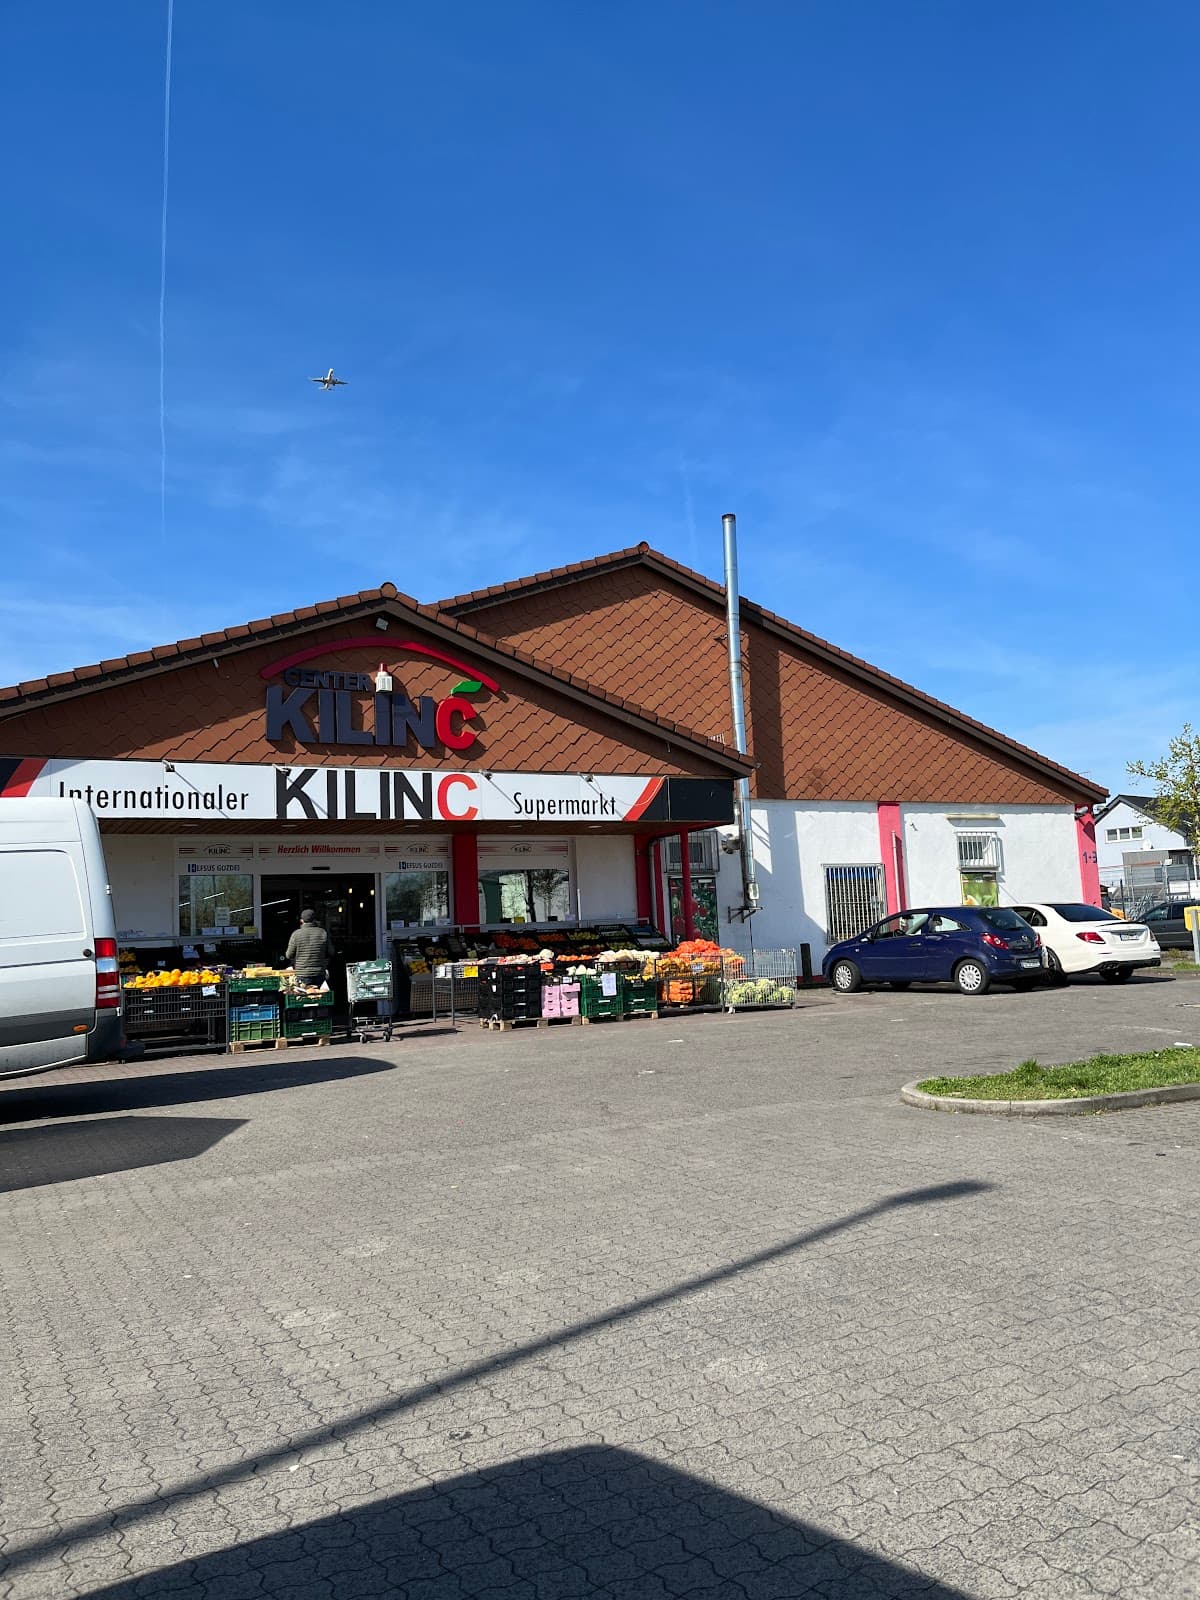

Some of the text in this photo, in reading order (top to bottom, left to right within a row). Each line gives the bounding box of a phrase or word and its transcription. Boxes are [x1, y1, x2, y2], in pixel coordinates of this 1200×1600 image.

[284, 669, 371, 692] CENTER
[266, 684, 477, 750] KILINC
[275, 768, 479, 821] KILINC
[513, 791, 617, 821] Supermarkt
[277, 844, 361, 855] Herzlich Willkommen
